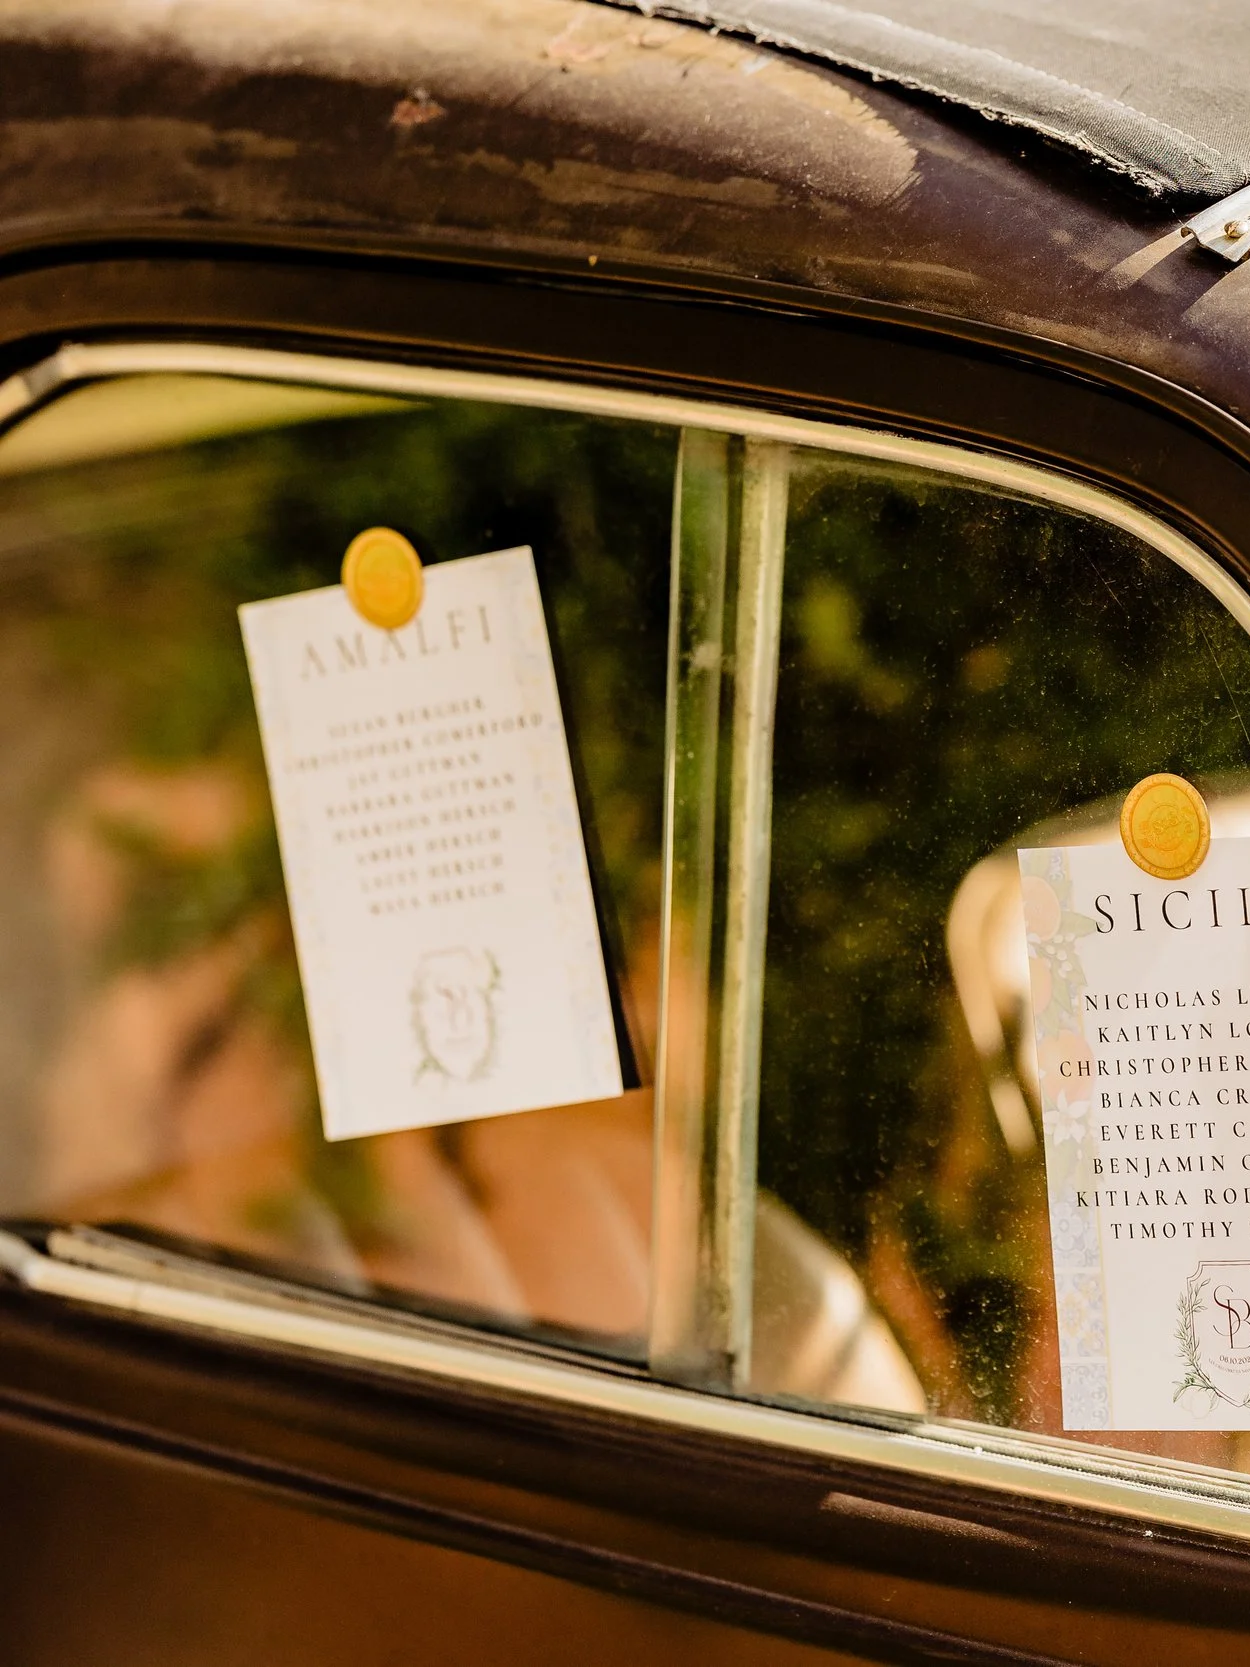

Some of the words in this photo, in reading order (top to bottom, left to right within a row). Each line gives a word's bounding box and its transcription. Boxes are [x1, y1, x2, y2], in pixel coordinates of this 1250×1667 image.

[299, 605, 492, 681] AMALFI
[1085, 990, 1220, 1011] NICHOLAS
[1098, 1023, 1212, 1043] KAITLYN
[1060, 1055, 1248, 1077] CHRISTOPHER
[1101, 1090, 1200, 1108] BIANCA
[1101, 1122, 1215, 1141] EVERETT
[1093, 1155, 1224, 1178] BENJAMIN
[1077, 1190, 1187, 1207] KITIARA
[1111, 1222, 1232, 1239] TIMOTHY
